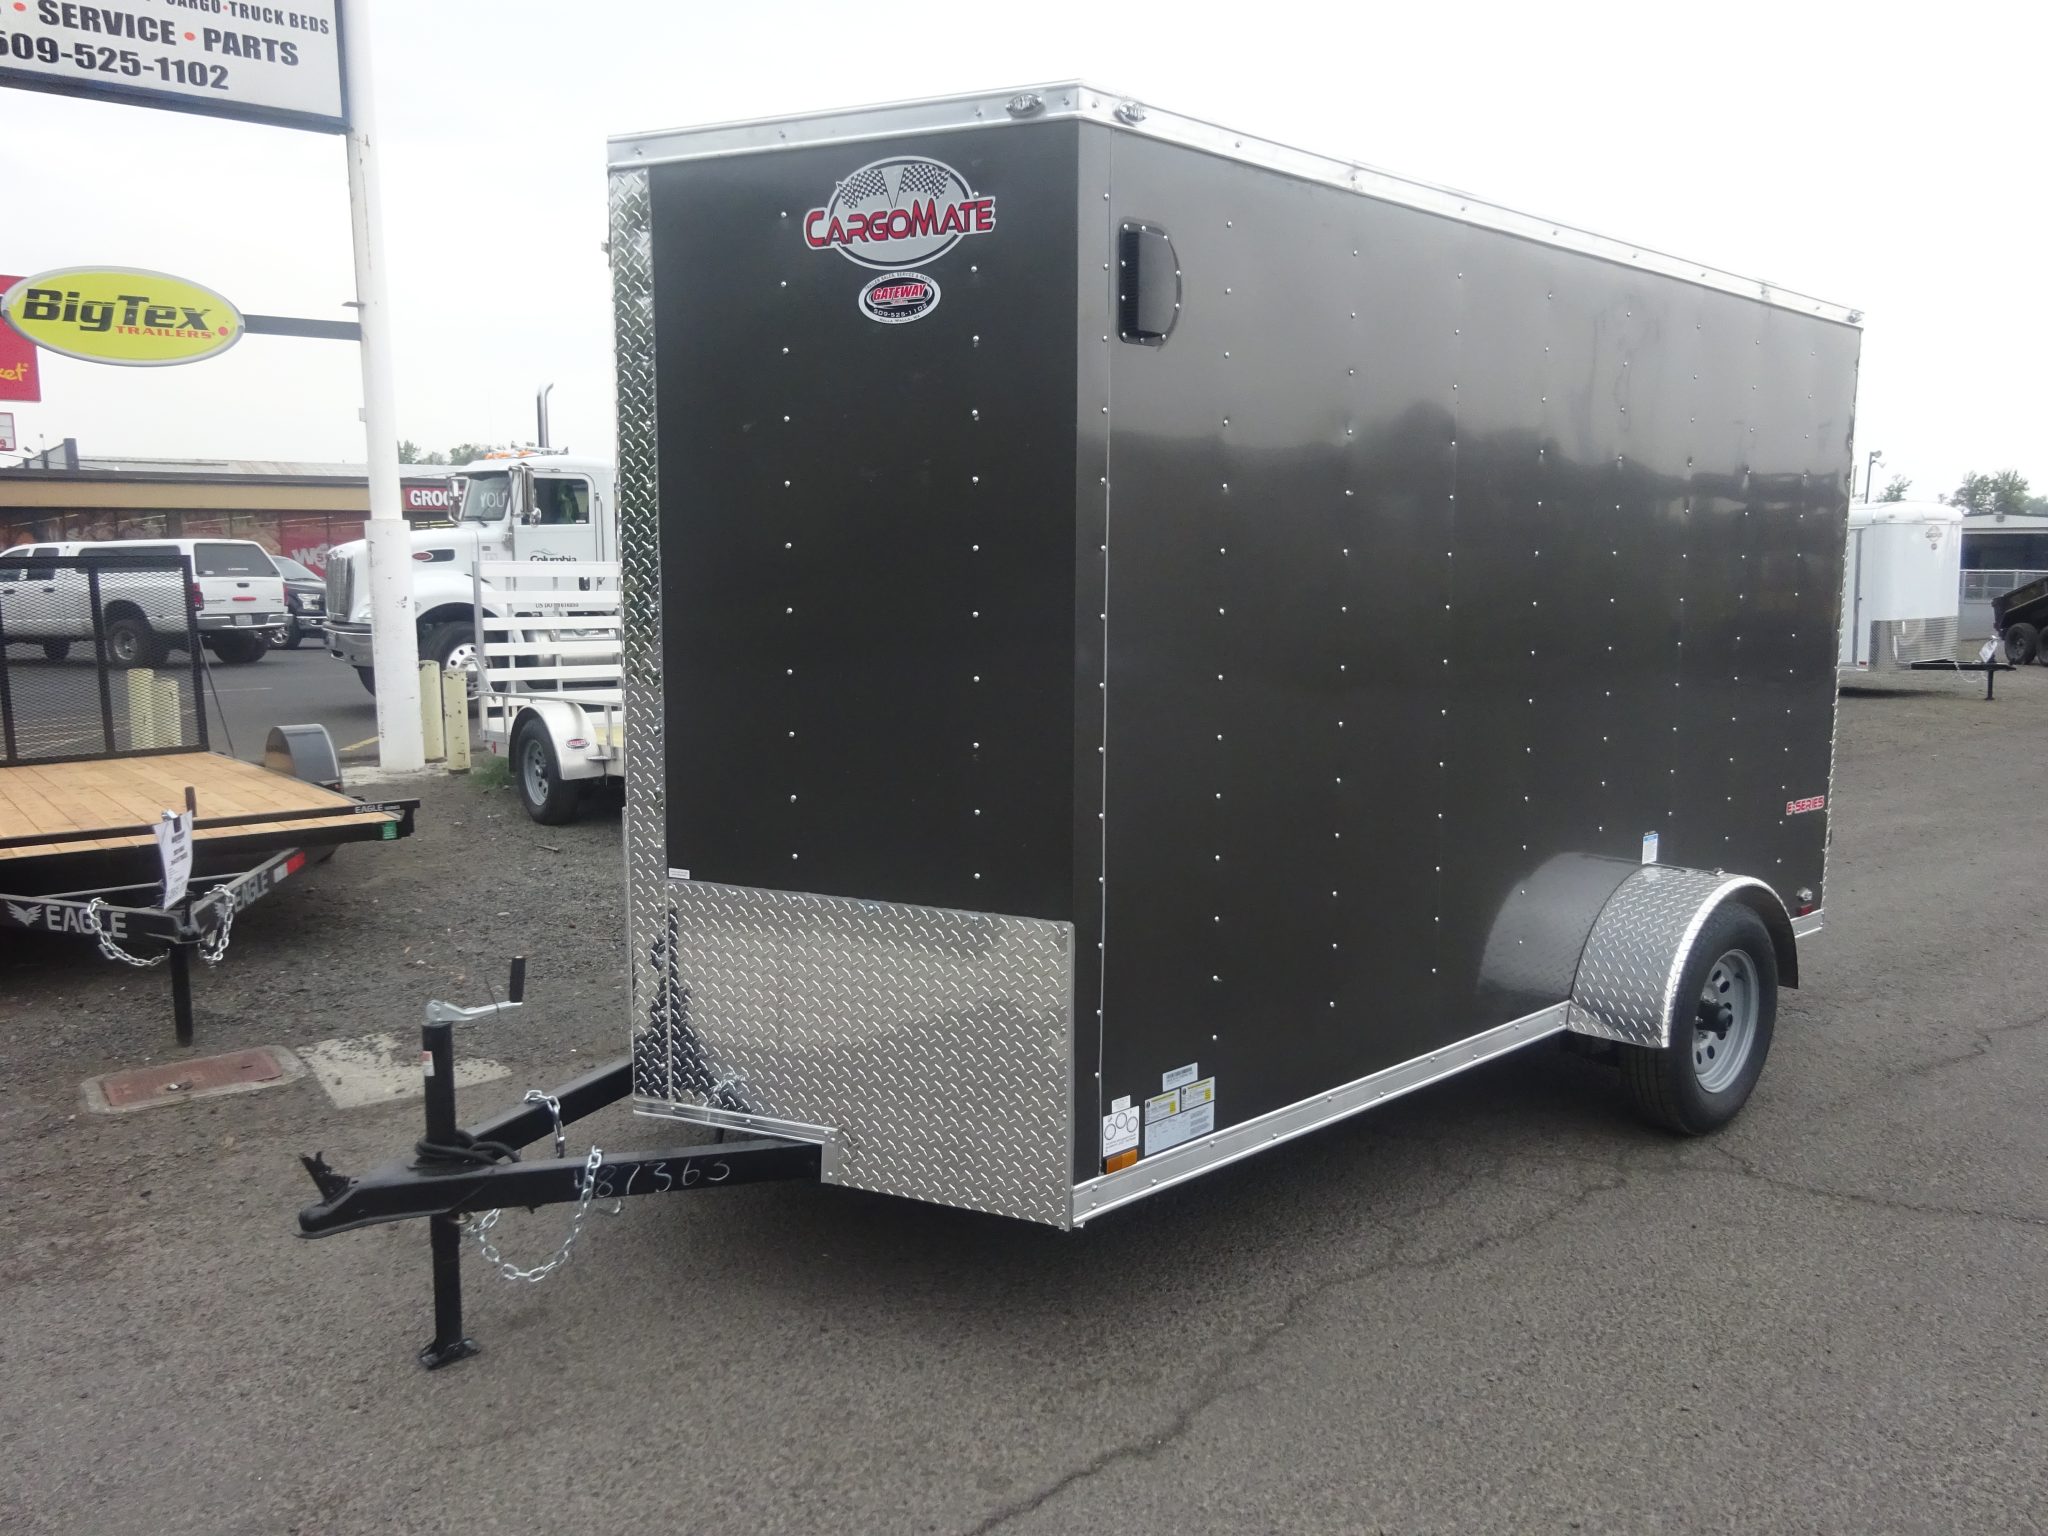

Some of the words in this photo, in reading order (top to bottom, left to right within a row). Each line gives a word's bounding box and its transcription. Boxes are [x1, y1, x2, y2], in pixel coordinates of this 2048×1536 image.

[229, 1, 285, 25] TRUCK
[289, 13, 330, 34] BEDS
[38, 0, 176, 46] SERVICE
[203, 28, 299, 66] PARTS
[873, 284, 926, 301] GATEWAY
[873, 303, 928, 318] 509-525-1102
[115, 325, 213, 340] TRAILERS
[354, 804, 384, 814] EAGLE
